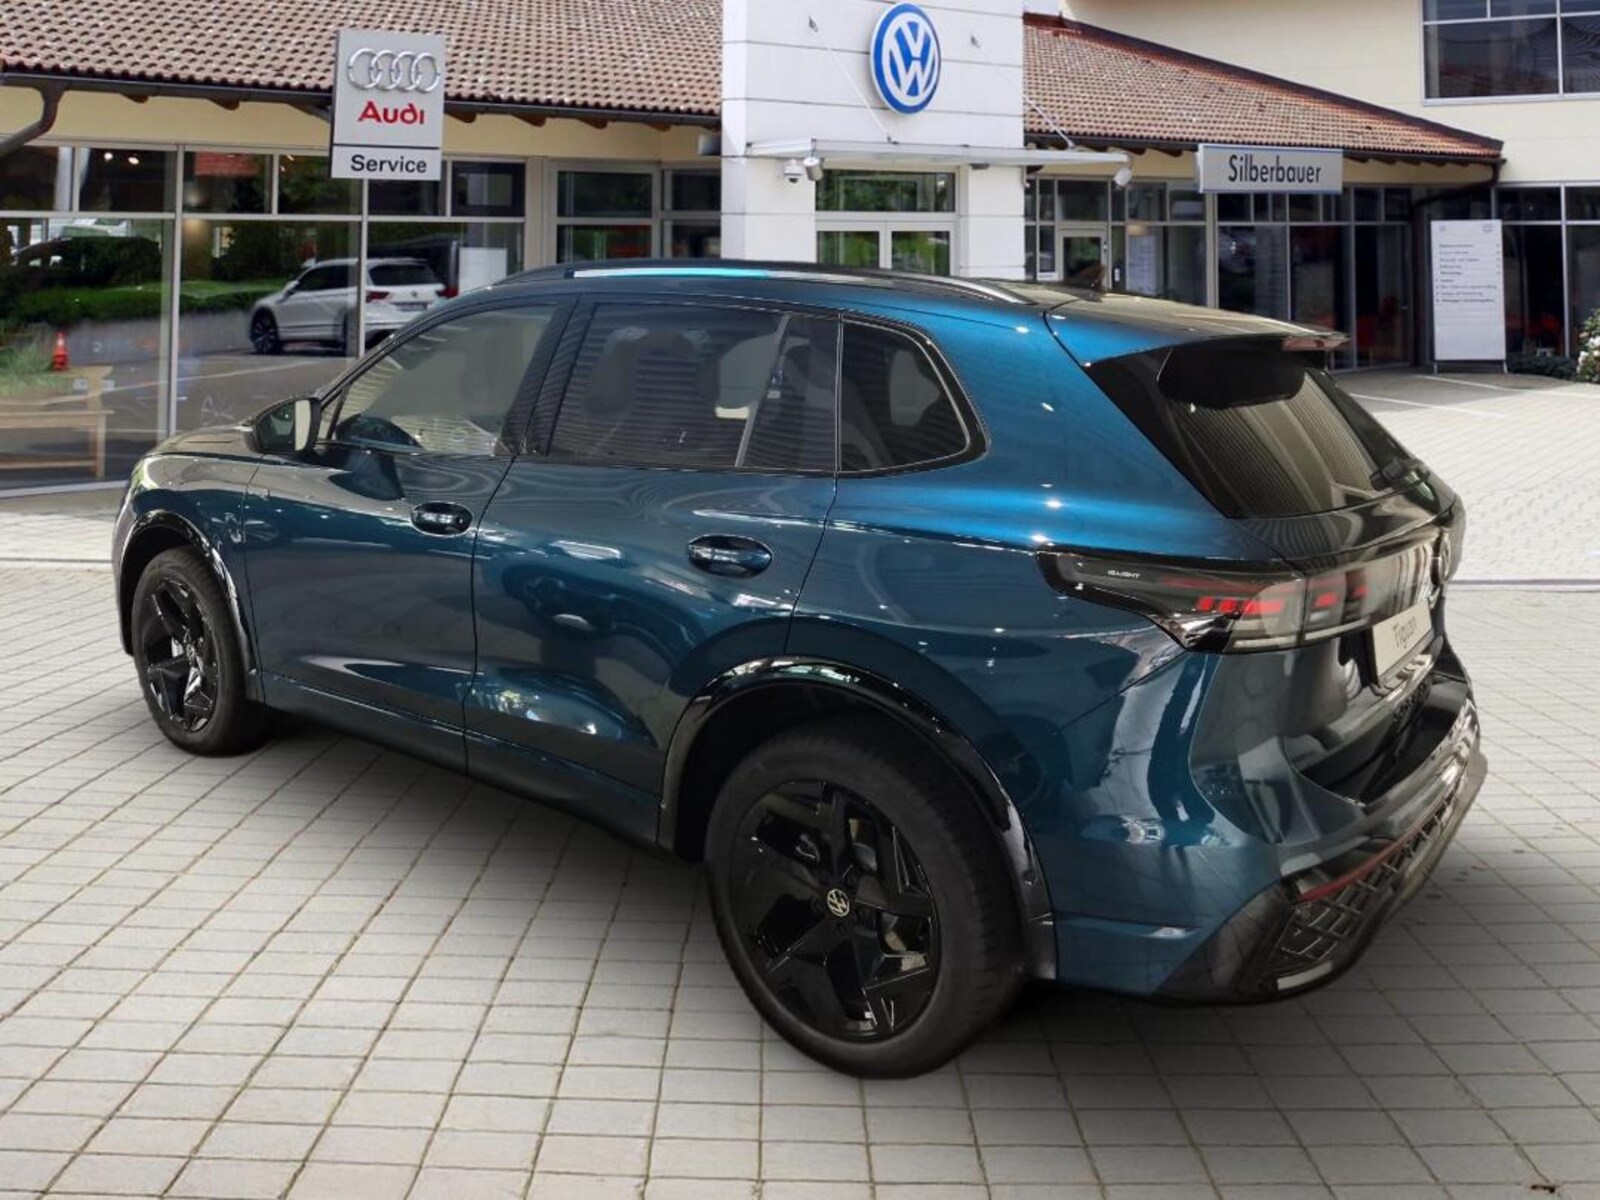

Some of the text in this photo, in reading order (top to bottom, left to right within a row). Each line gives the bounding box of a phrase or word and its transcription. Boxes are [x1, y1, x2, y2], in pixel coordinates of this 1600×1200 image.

[880, 11, 937, 106] VW
[357, 100, 425, 125] Audi
[350, 154, 427, 173] Service
[1228, 153, 1321, 183] Silberbauer
